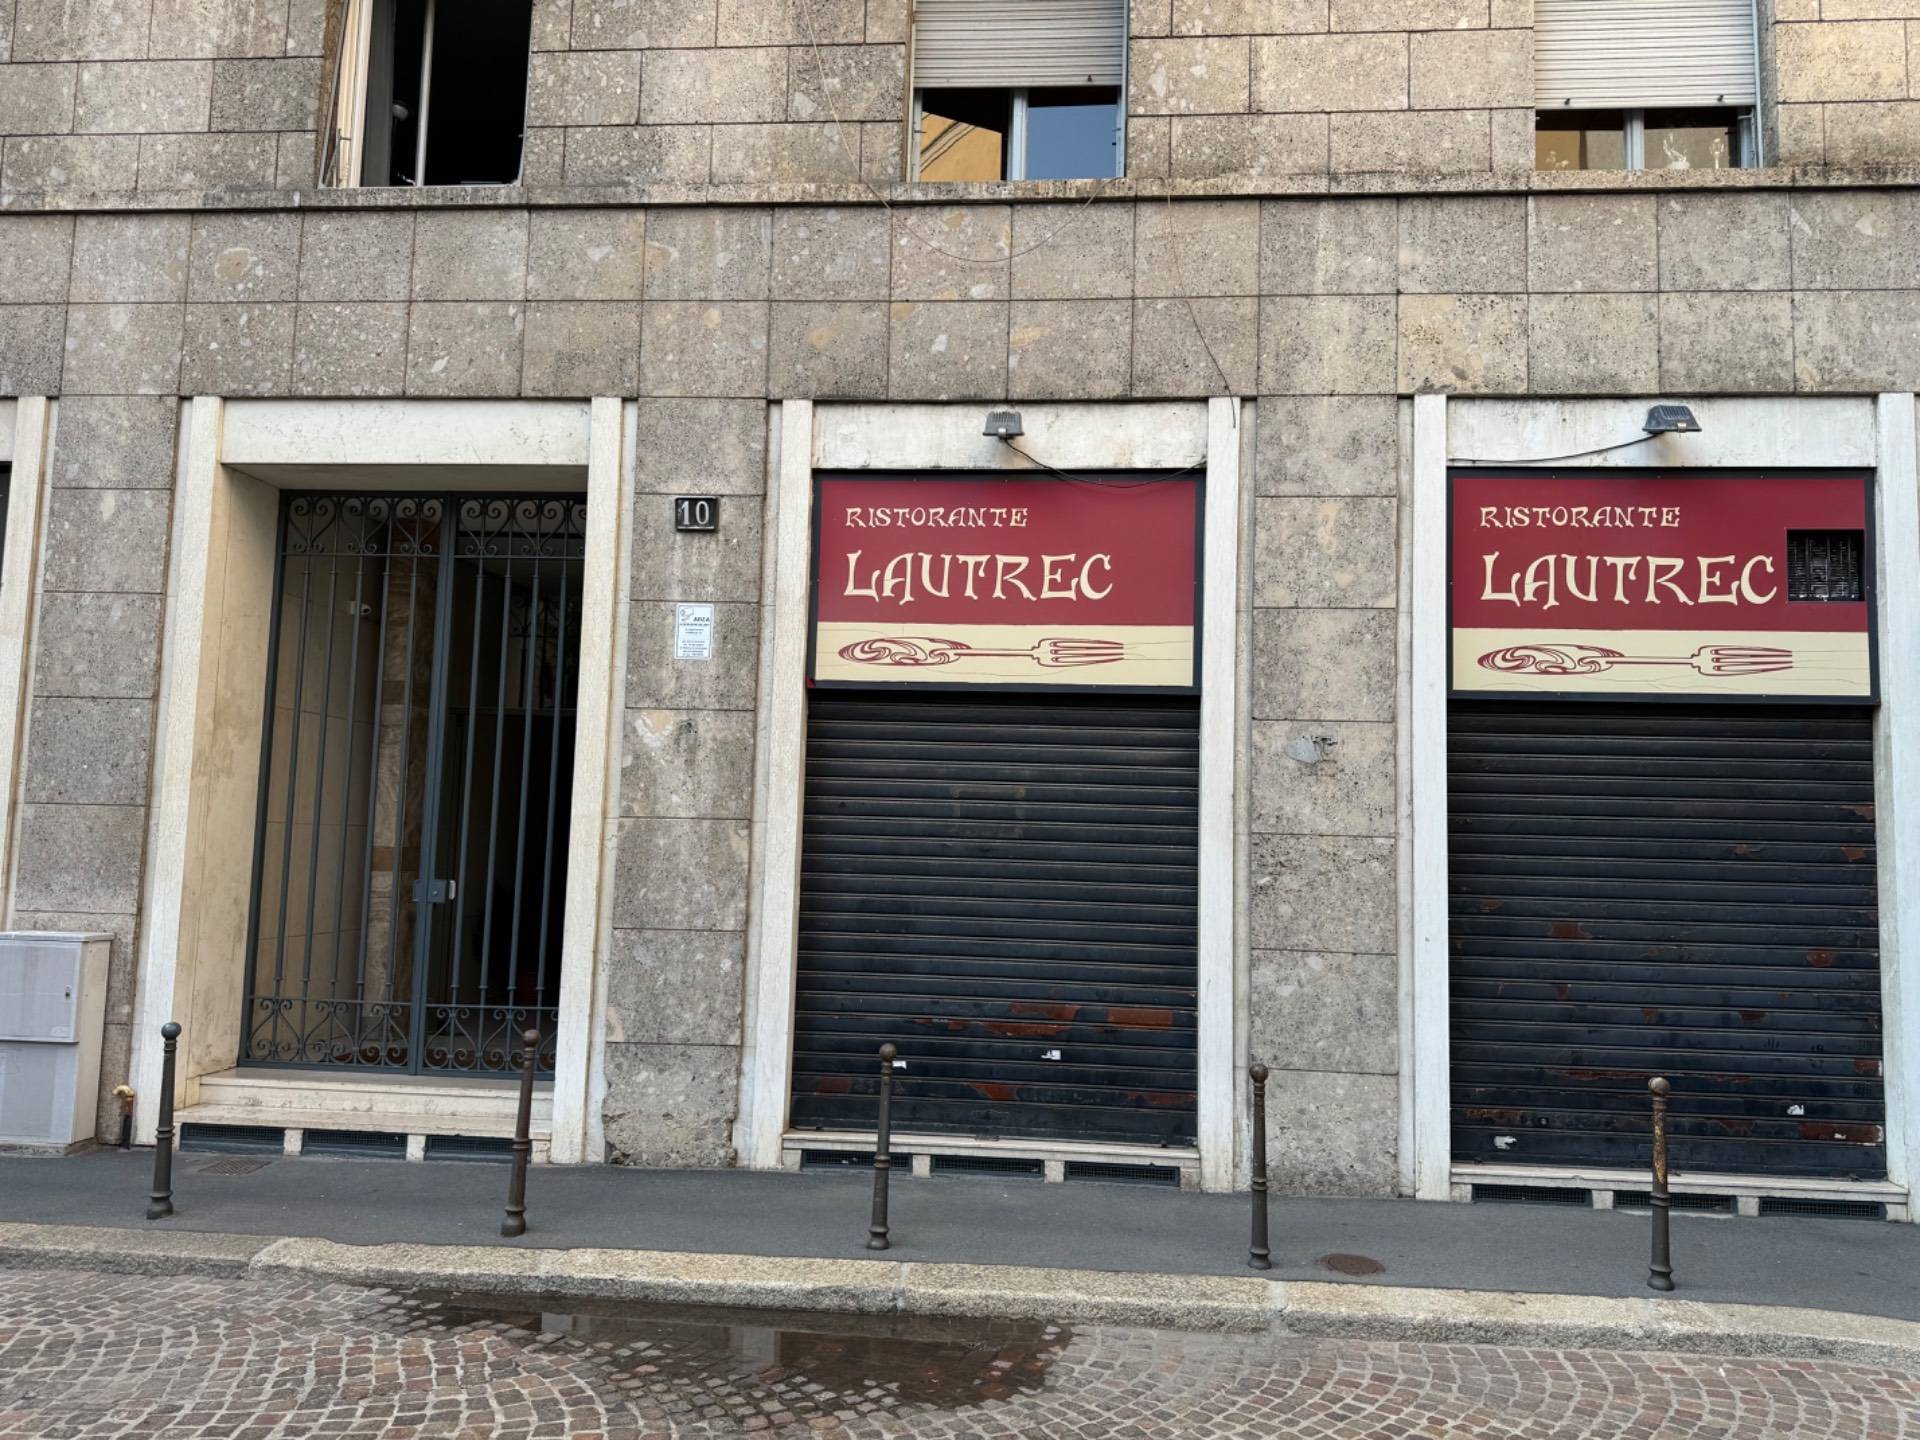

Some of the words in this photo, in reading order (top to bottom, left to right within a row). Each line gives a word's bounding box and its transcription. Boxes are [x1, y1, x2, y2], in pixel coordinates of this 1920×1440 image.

[681, 500, 710, 525] 10
[845, 506, 1028, 528] RISTORANTE
[1479, 506, 1680, 528] RISTORANTE
[843, 549, 1113, 606] LAUTREC
[1479, 551, 1777, 611] LAUTREC
